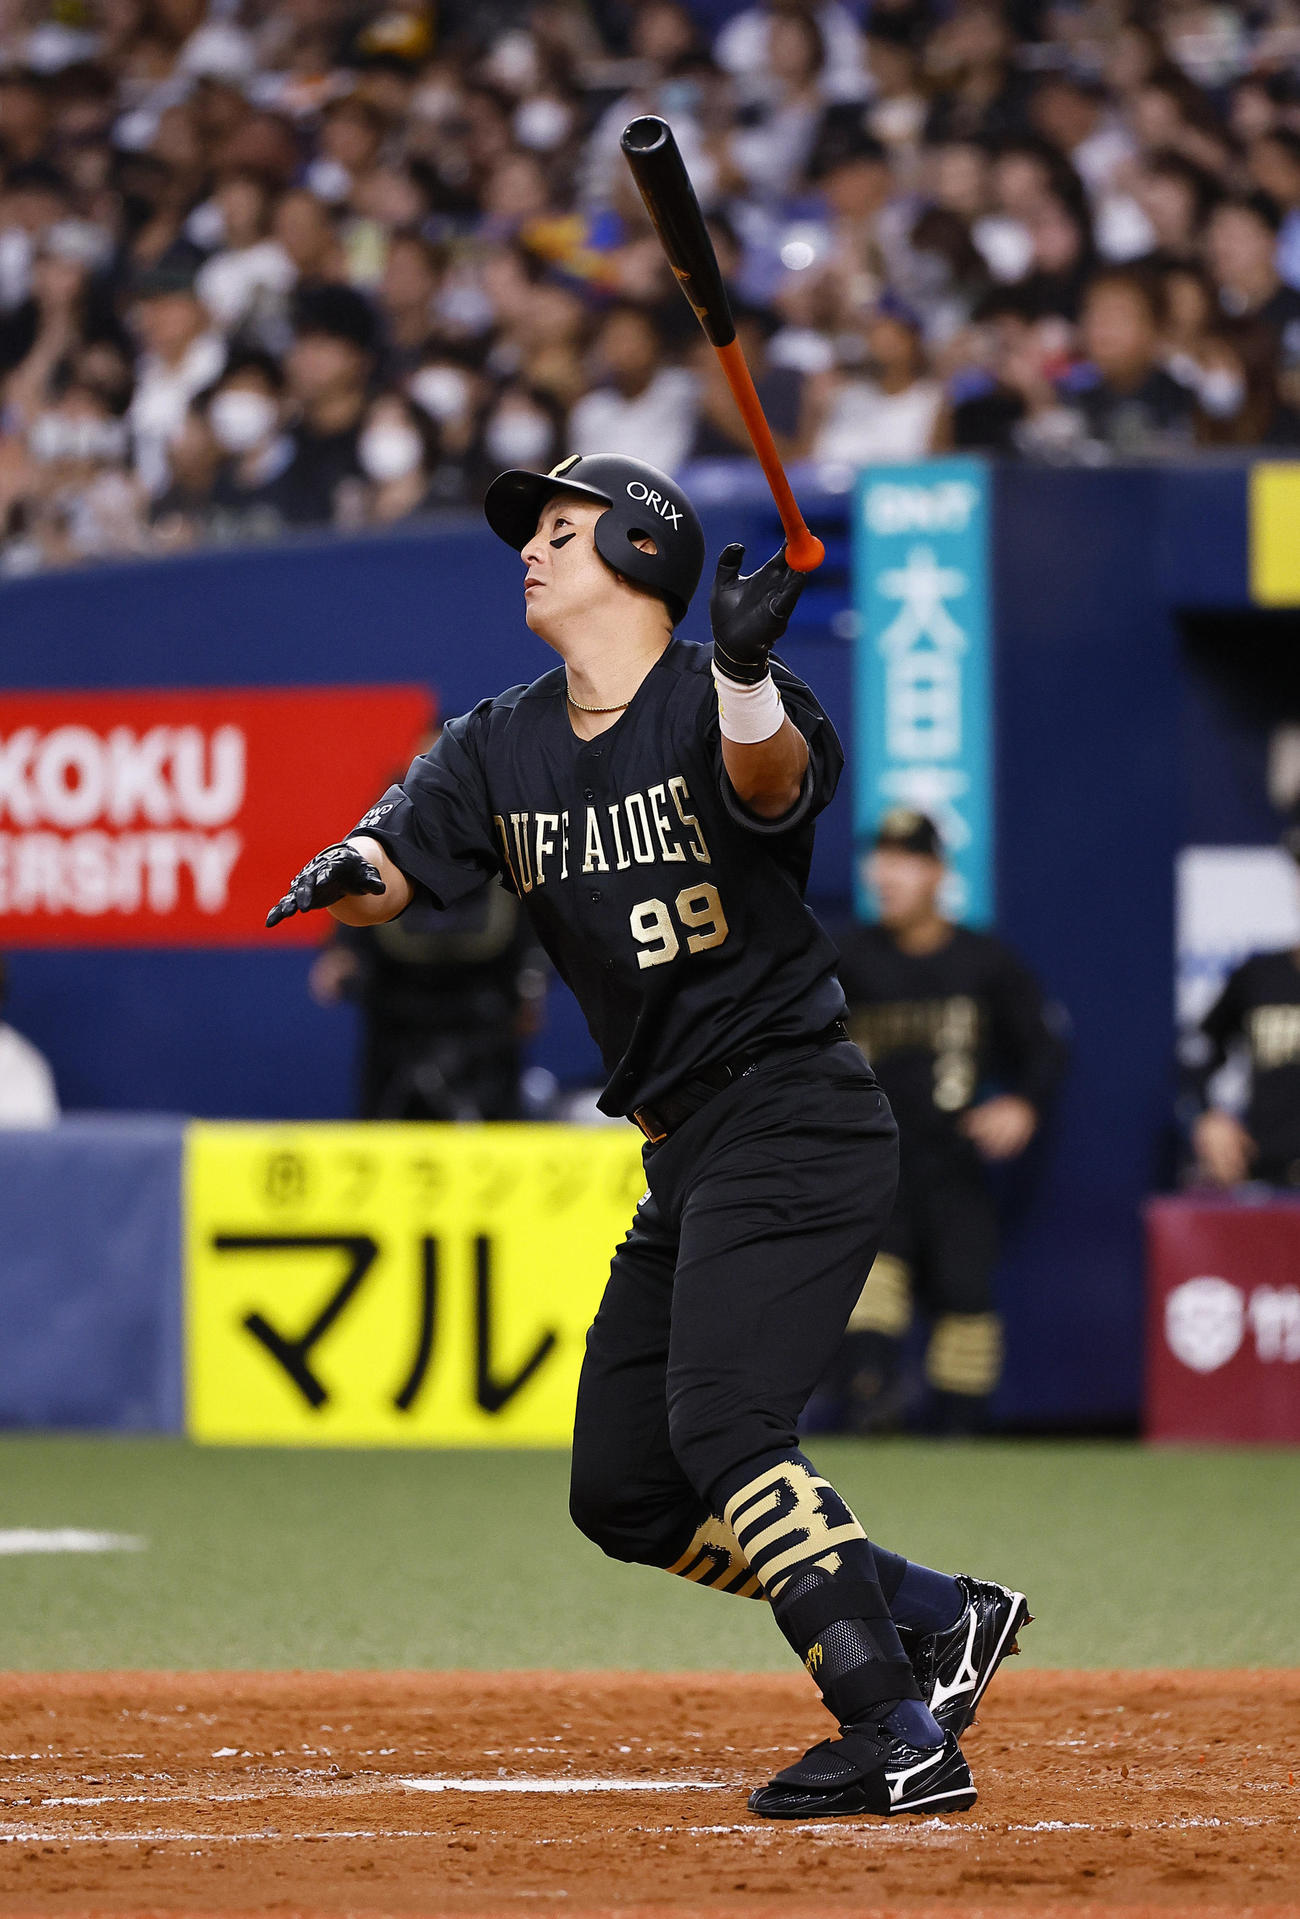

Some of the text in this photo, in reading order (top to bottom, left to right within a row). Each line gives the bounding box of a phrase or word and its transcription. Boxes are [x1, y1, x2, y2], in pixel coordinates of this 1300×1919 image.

[626, 481, 684, 531] ORIX
[0, 831, 241, 914] RSITY
[629, 882, 729, 969] 99
[213, 1233, 558, 1412] マル
